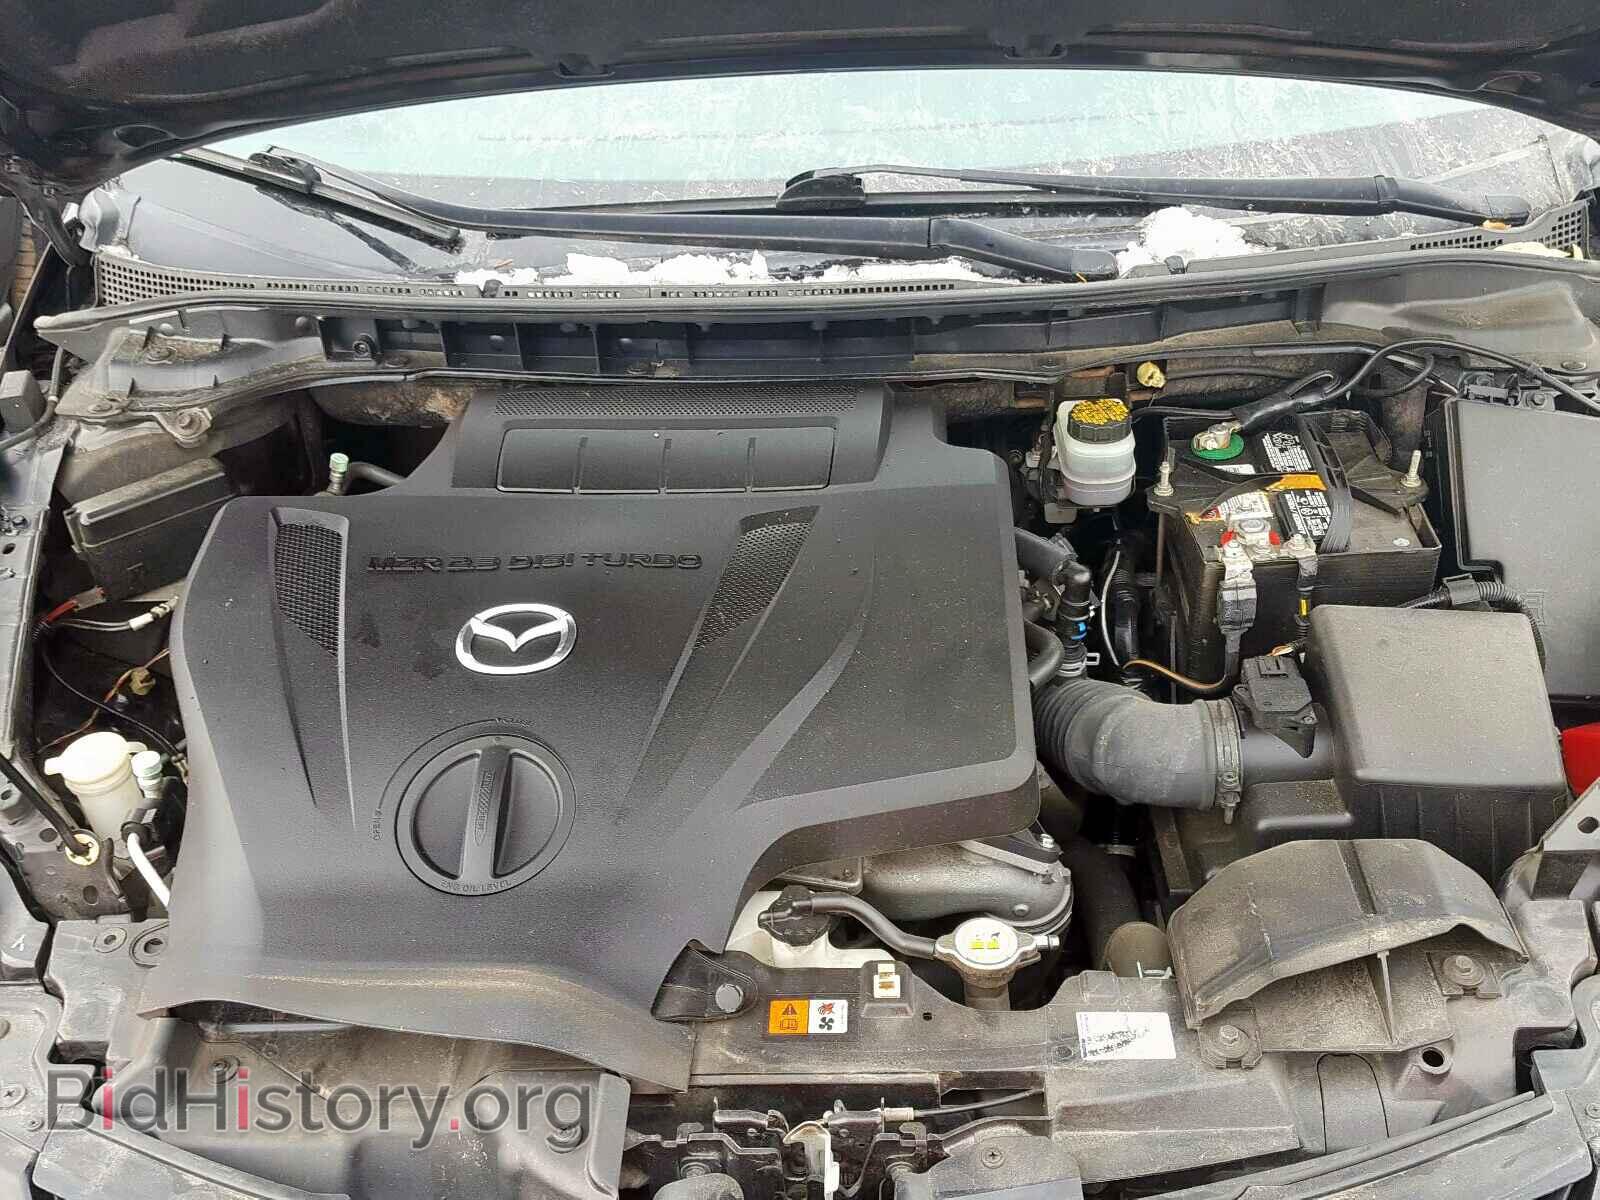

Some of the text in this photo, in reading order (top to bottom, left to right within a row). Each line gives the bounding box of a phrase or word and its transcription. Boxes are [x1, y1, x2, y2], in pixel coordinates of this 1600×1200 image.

[367, 552, 703, 573] MZR 2.3 DISI TURBO
